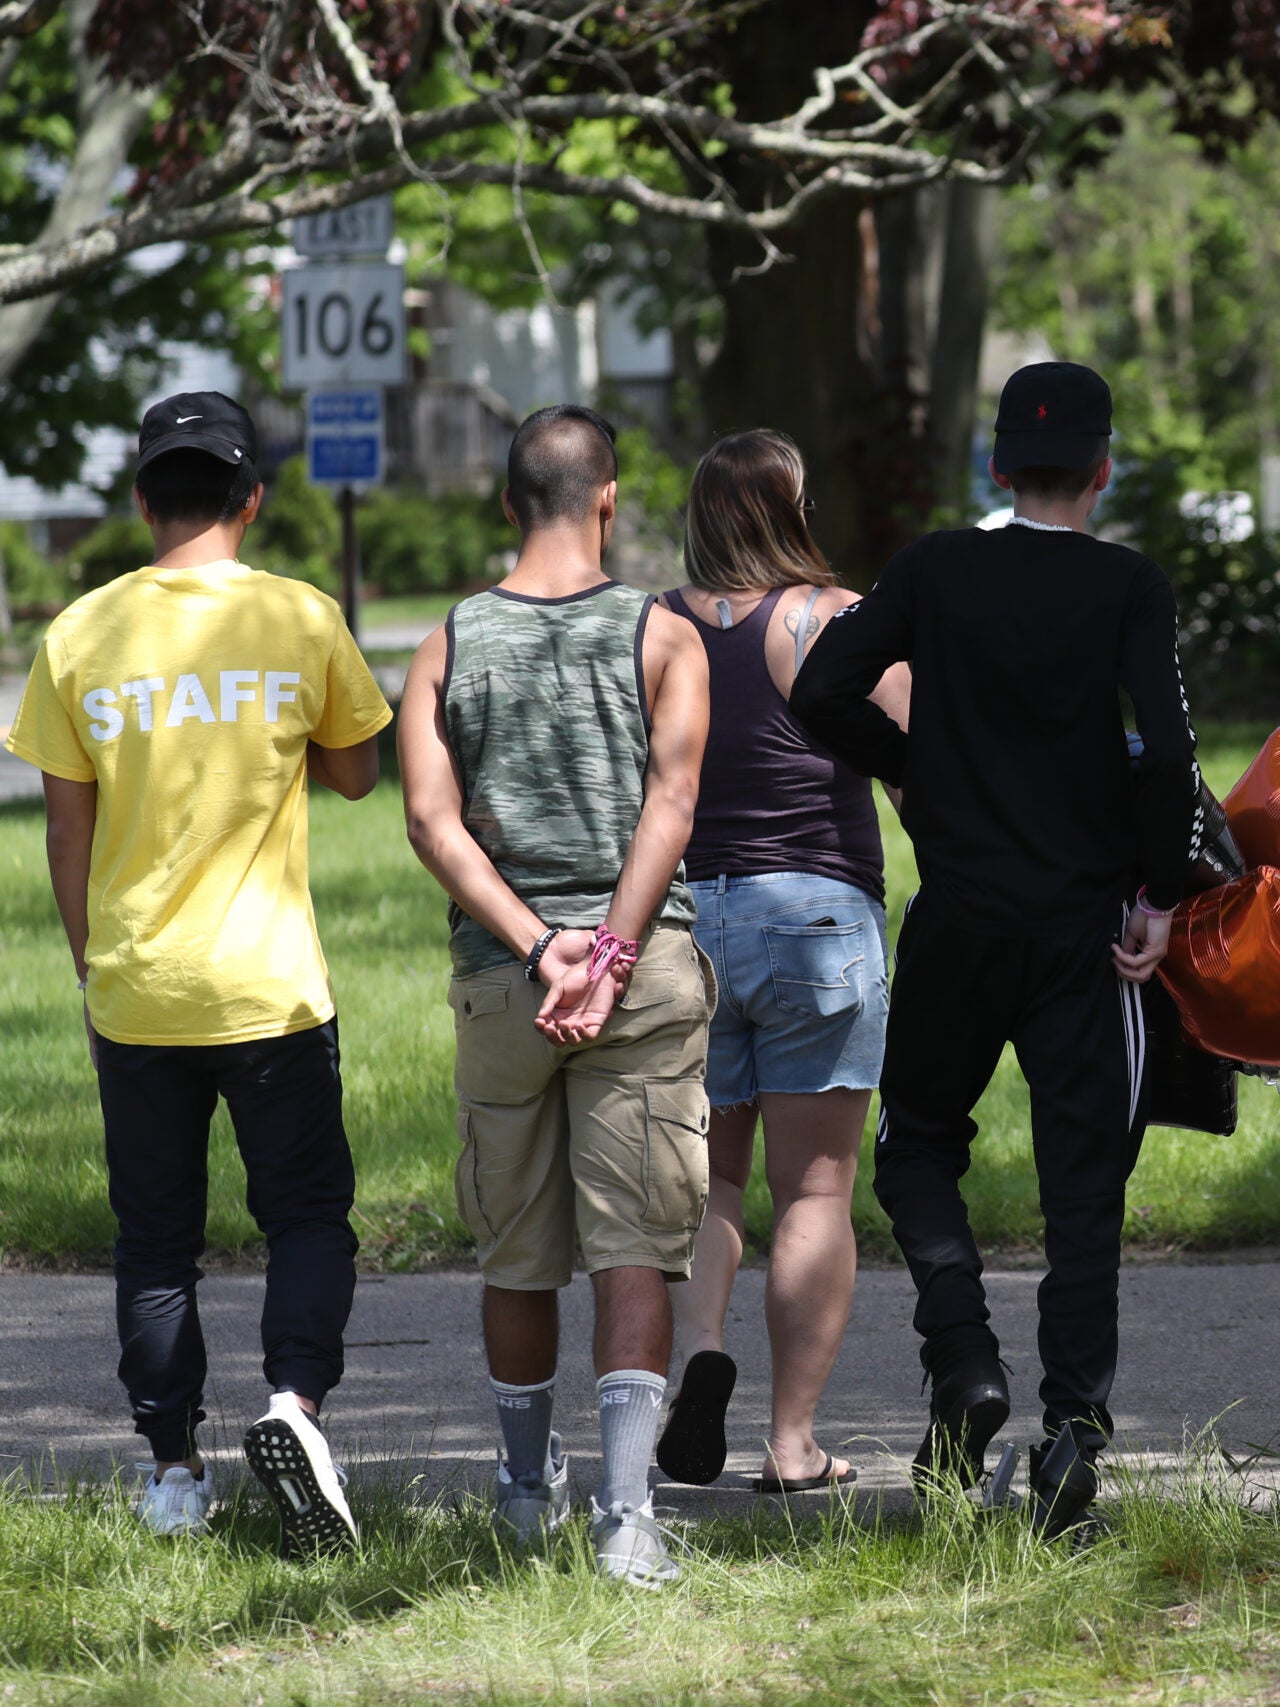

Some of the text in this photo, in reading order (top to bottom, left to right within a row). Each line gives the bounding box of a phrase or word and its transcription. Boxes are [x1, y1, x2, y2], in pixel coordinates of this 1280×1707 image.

[308, 205, 378, 244] EAST
[296, 291, 395, 359] 106
[83, 670, 301, 741] STAFF
